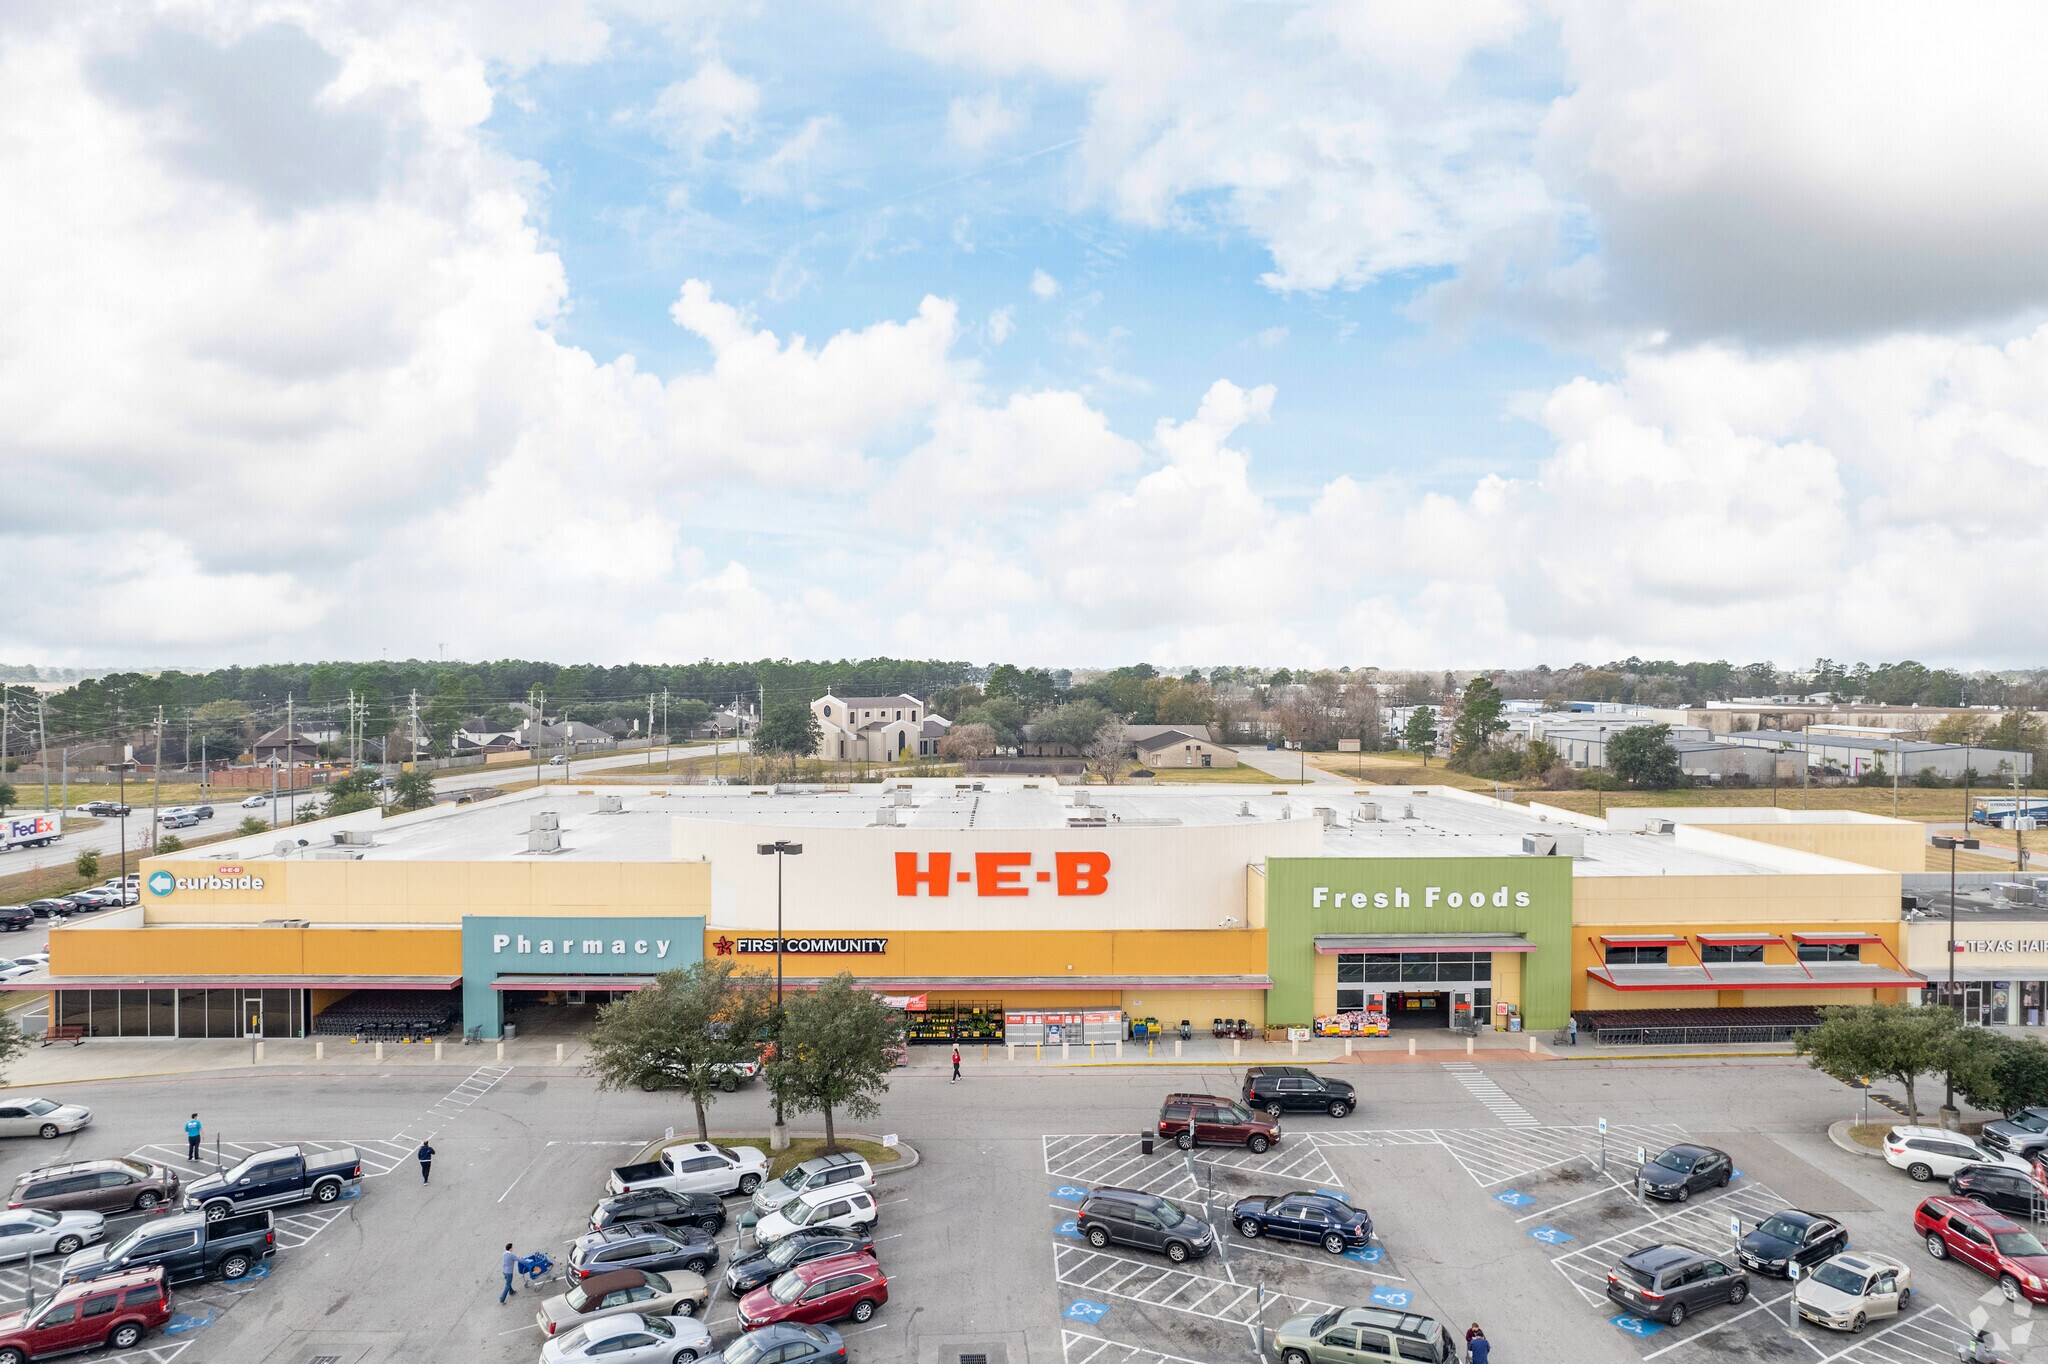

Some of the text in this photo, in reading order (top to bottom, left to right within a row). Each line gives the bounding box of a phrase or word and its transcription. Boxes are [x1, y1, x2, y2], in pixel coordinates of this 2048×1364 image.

[12, 817, 53, 837] FedEx
[175, 874, 264, 890] curbside
[895, 851, 1111, 896] H-E-B
[1312, 886, 1531, 908] Fresh Foods
[493, 934, 671, 958] Pharmacy
[737, 939, 887, 952] FIRST COMMUNITY
[1967, 940, 2014, 952] TEXAS
